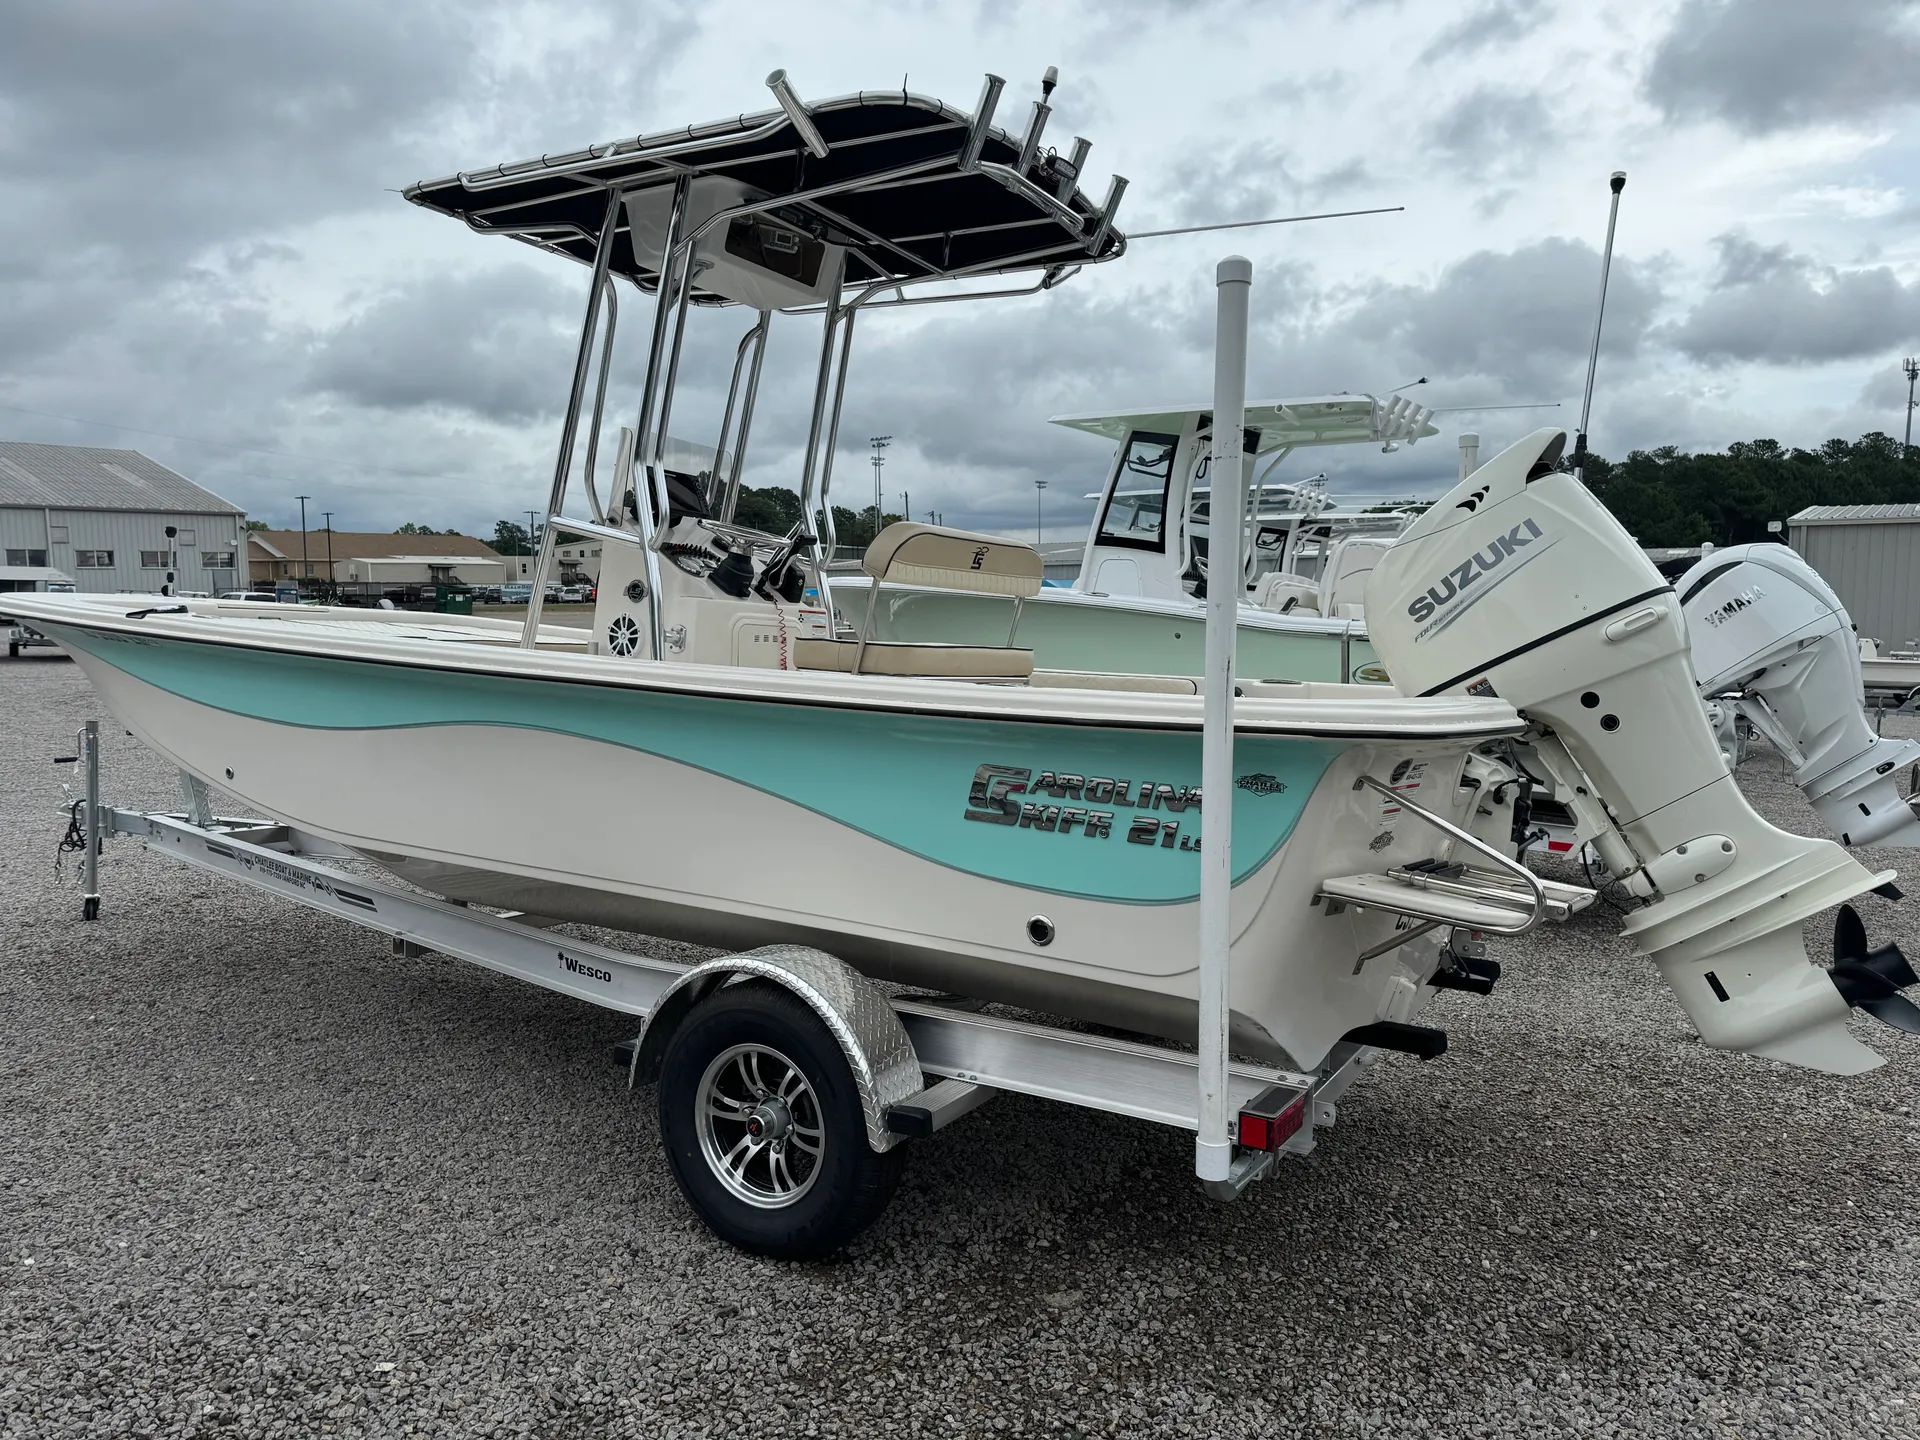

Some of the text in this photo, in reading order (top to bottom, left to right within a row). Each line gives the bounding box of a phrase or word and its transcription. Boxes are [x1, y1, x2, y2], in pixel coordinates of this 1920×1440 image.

[1408, 518, 1543, 623] SUZUKI
[1704, 584, 1767, 628] YAMAHA
[968, 763, 1202, 814] CAROLINA
[1127, 816, 1180, 849] 21
[255, 856, 275, 870] CHATLEE
[275, 863, 288, 874] BOAT
[292, 870, 311, 884] MARINE
